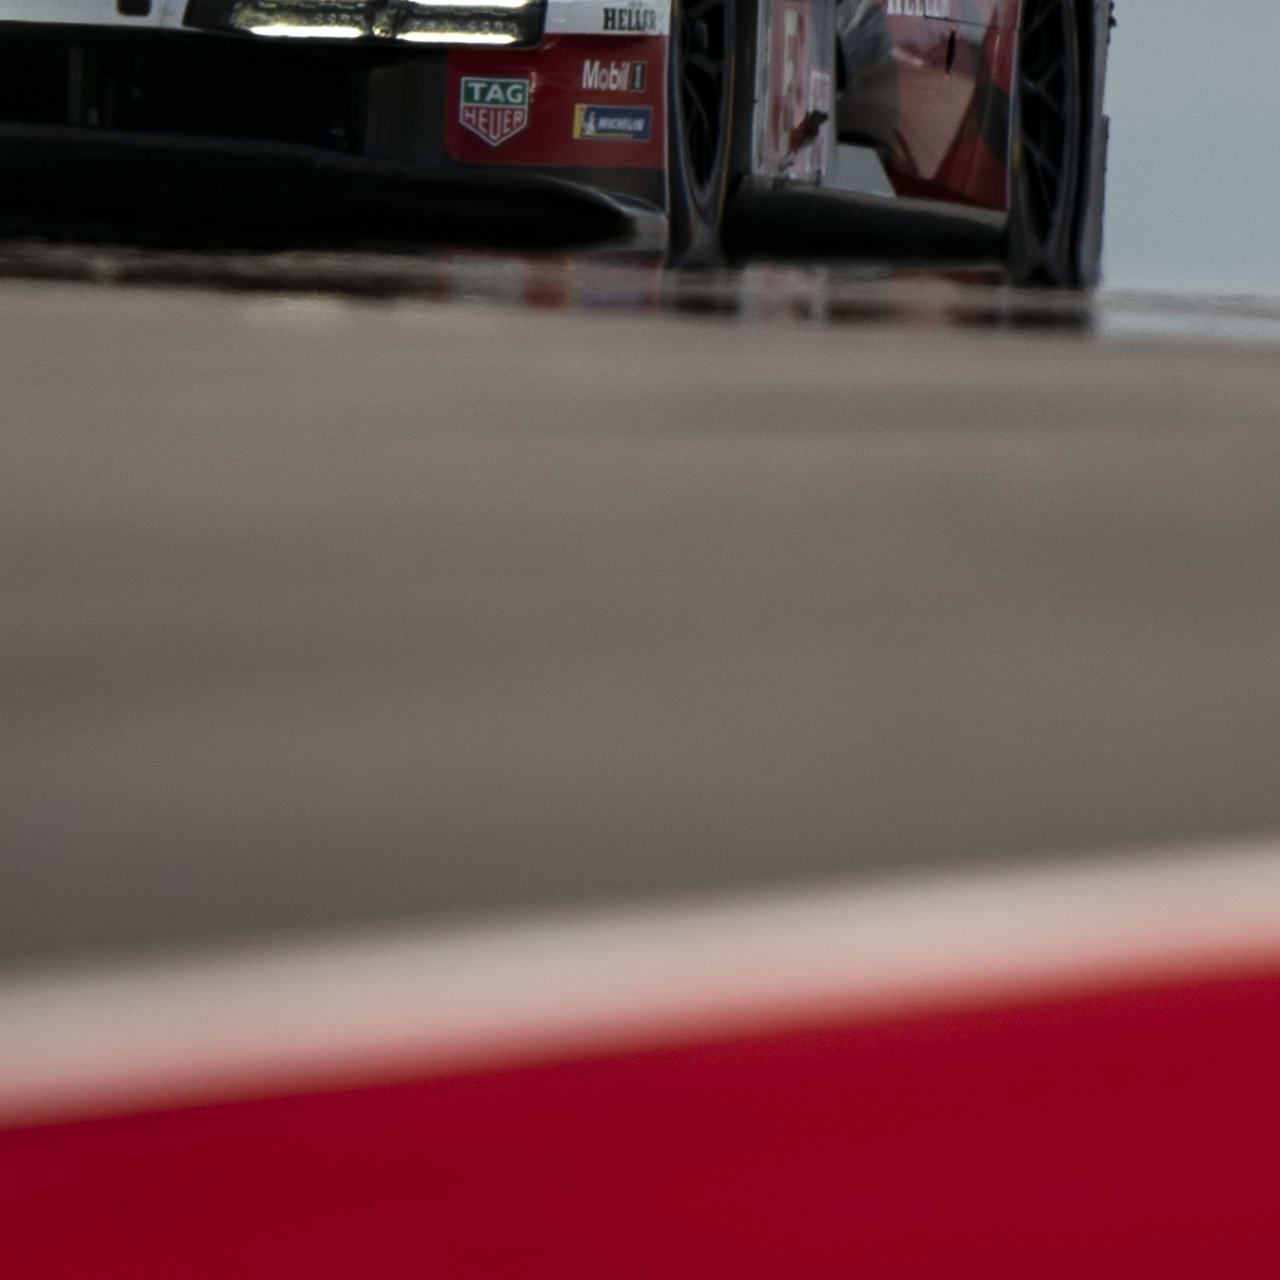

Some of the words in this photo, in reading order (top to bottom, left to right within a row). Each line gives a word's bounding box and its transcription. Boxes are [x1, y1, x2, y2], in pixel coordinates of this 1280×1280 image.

[582, 59, 630, 91] Mobil
[468, 82, 524, 104] TAG
[463, 107, 524, 141] HEUER
